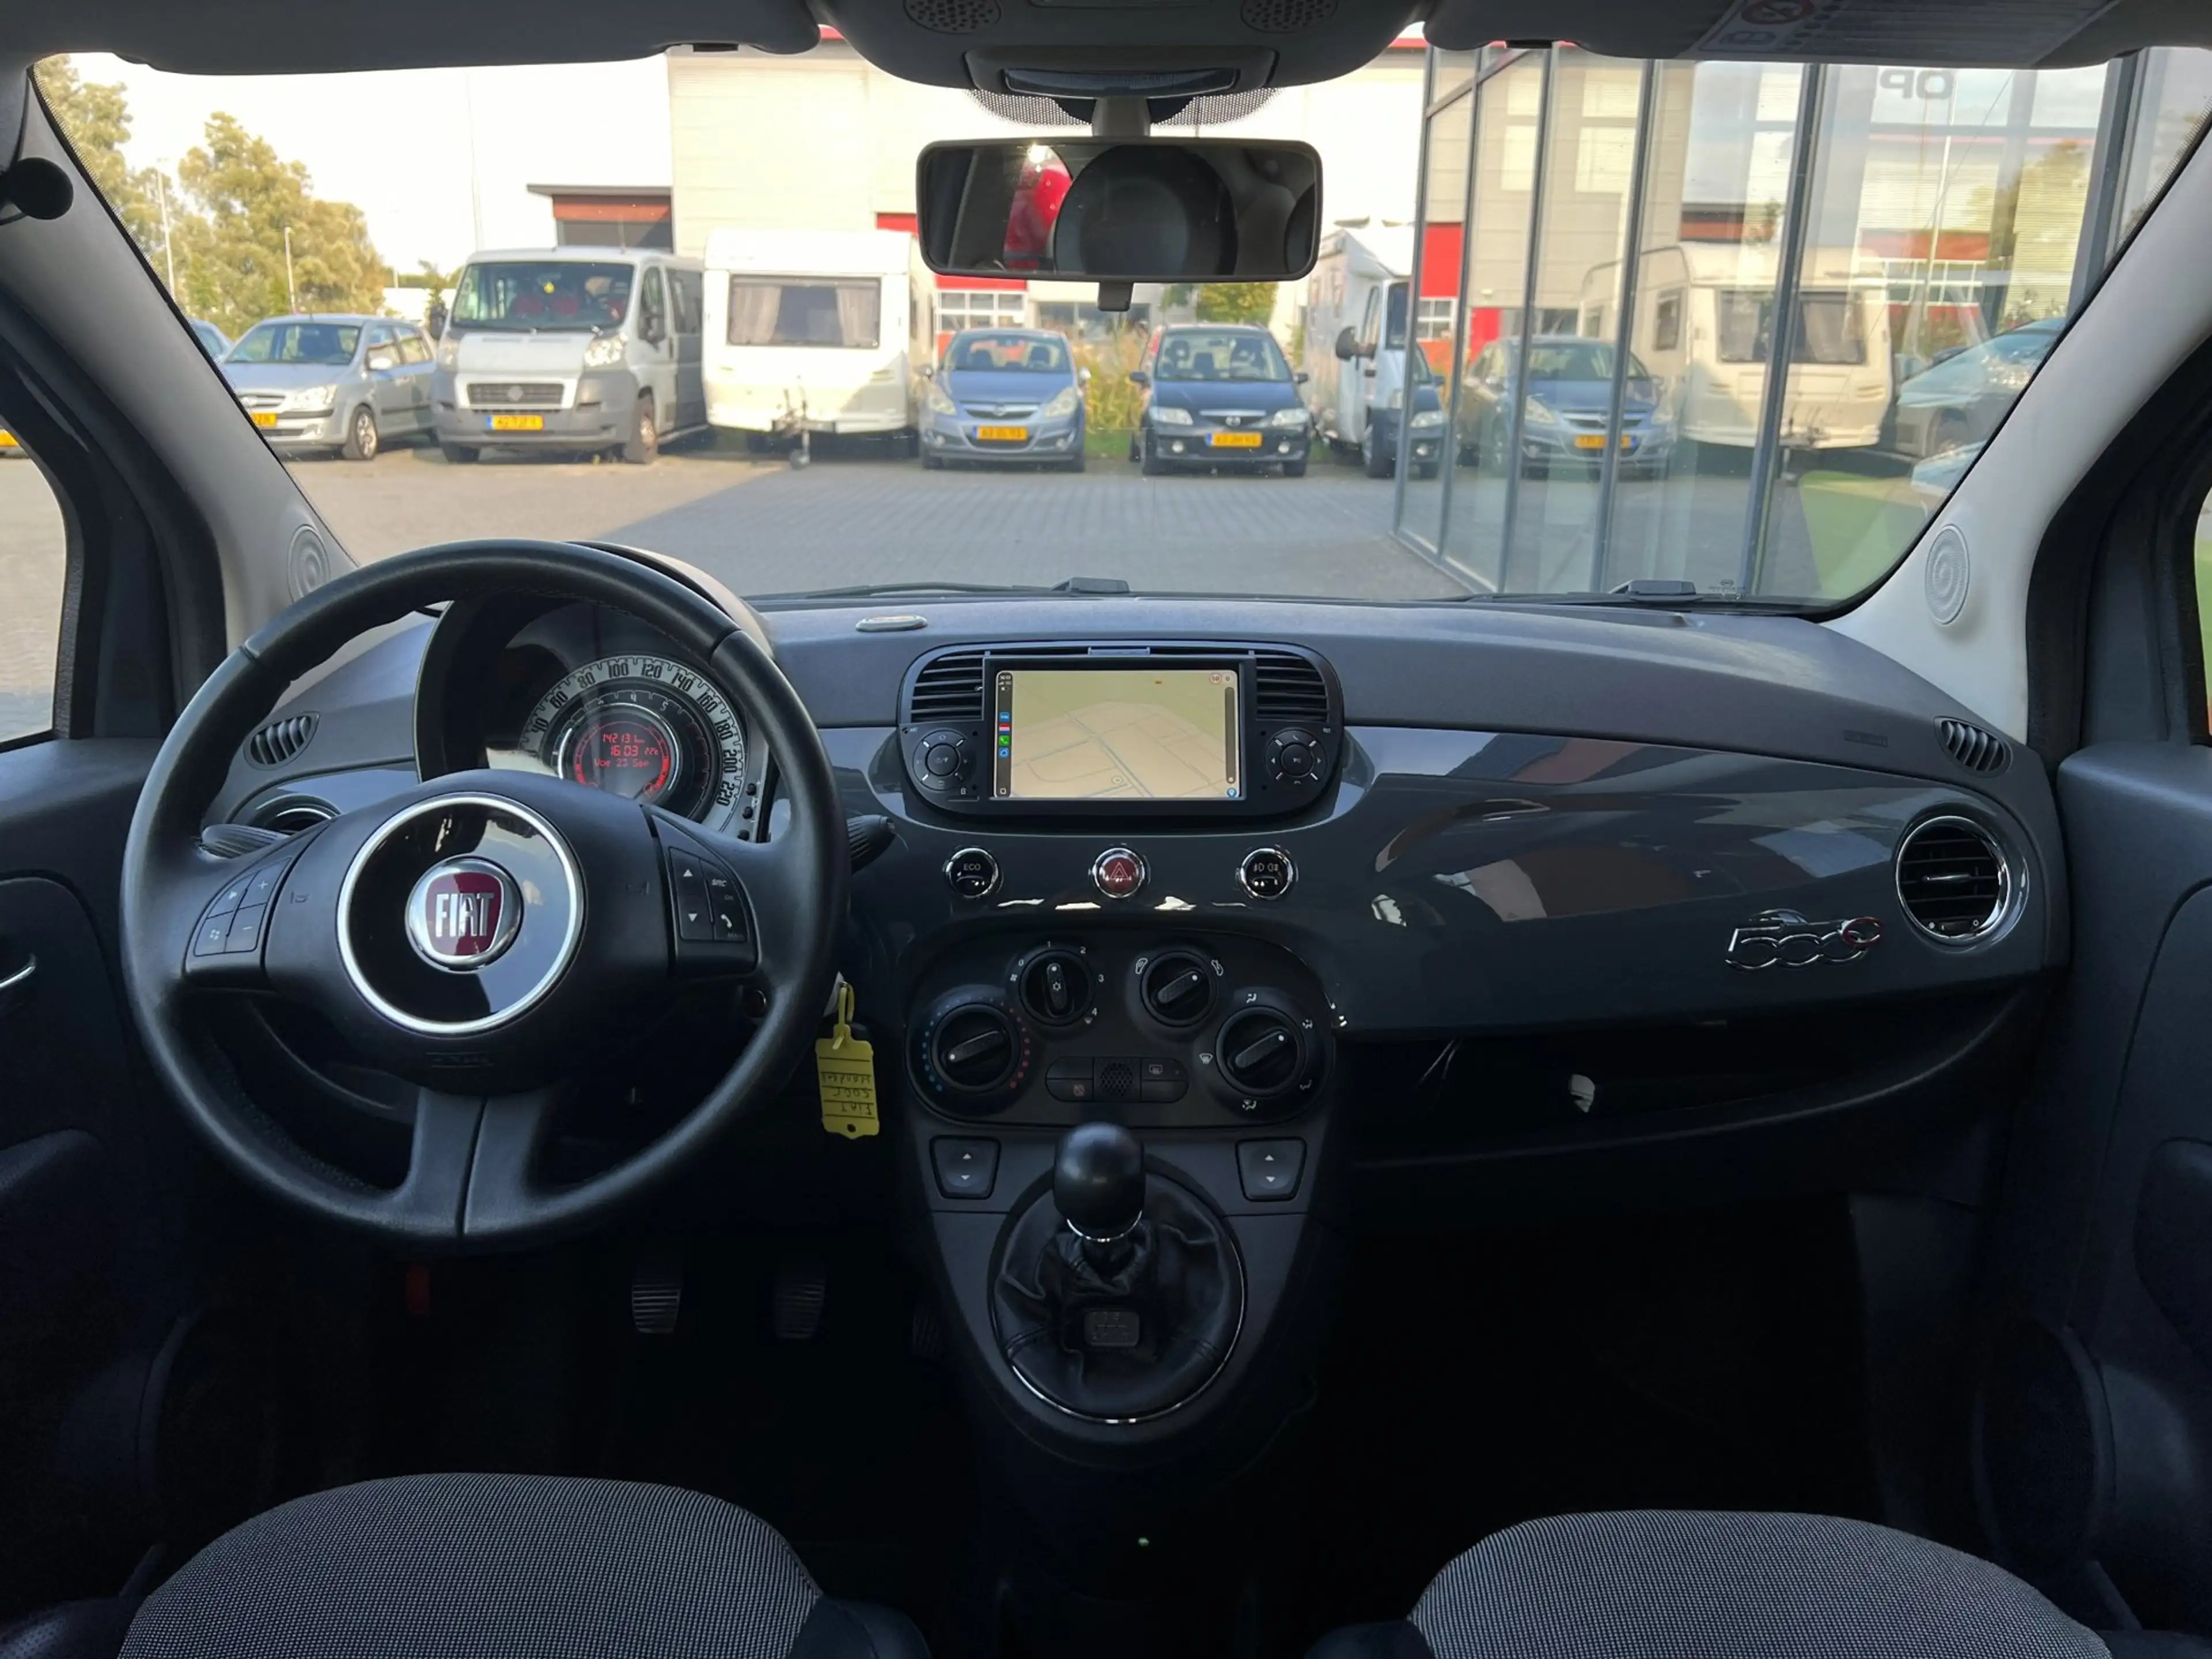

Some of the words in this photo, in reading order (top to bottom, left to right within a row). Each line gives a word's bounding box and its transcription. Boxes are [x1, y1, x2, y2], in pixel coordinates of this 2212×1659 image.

[608, 662, 629, 678] 100
[641, 664, 662, 679] 120
[577, 672, 596, 688] 80
[671, 672, 694, 692] 140
[550, 691, 568, 709] 60
[698, 692, 716, 713] 160
[531, 718, 548, 733] 40
[714, 719, 734, 740] 180
[723, 749, 737, 772] 200
[716, 781, 734, 806] 220
[435, 892, 494, 938] FIAT
[1097, 974, 1104, 983] 3
[1092, 1007, 1098, 1016] 4
